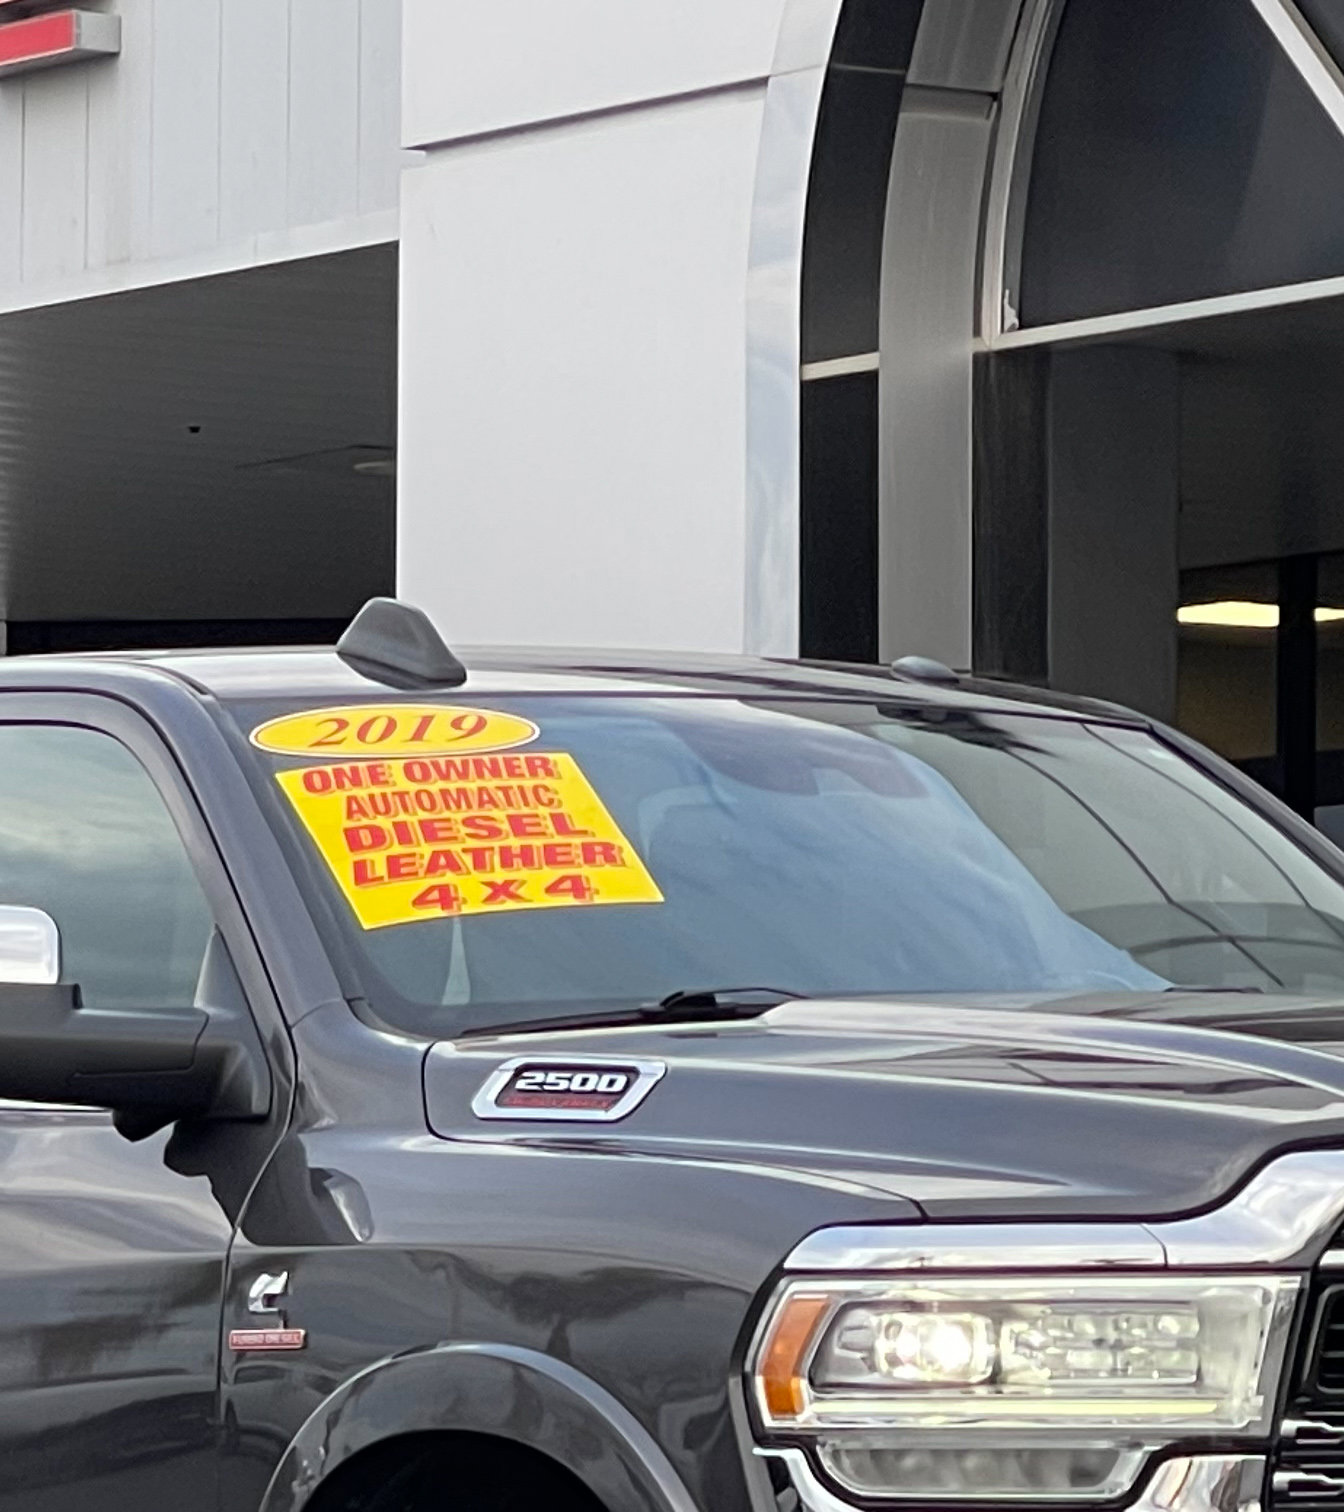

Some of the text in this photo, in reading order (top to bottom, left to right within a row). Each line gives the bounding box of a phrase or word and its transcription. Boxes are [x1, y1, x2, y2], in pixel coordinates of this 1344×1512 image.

[309, 713, 488, 749] 2019
[302, 755, 561, 795] ONE OWNER
[345, 784, 562, 822] AUTOMATIC
[343, 812, 595, 854] DIESEL
[353, 841, 627, 887] LEATHER
[514, 1071, 629, 1092] 2500
